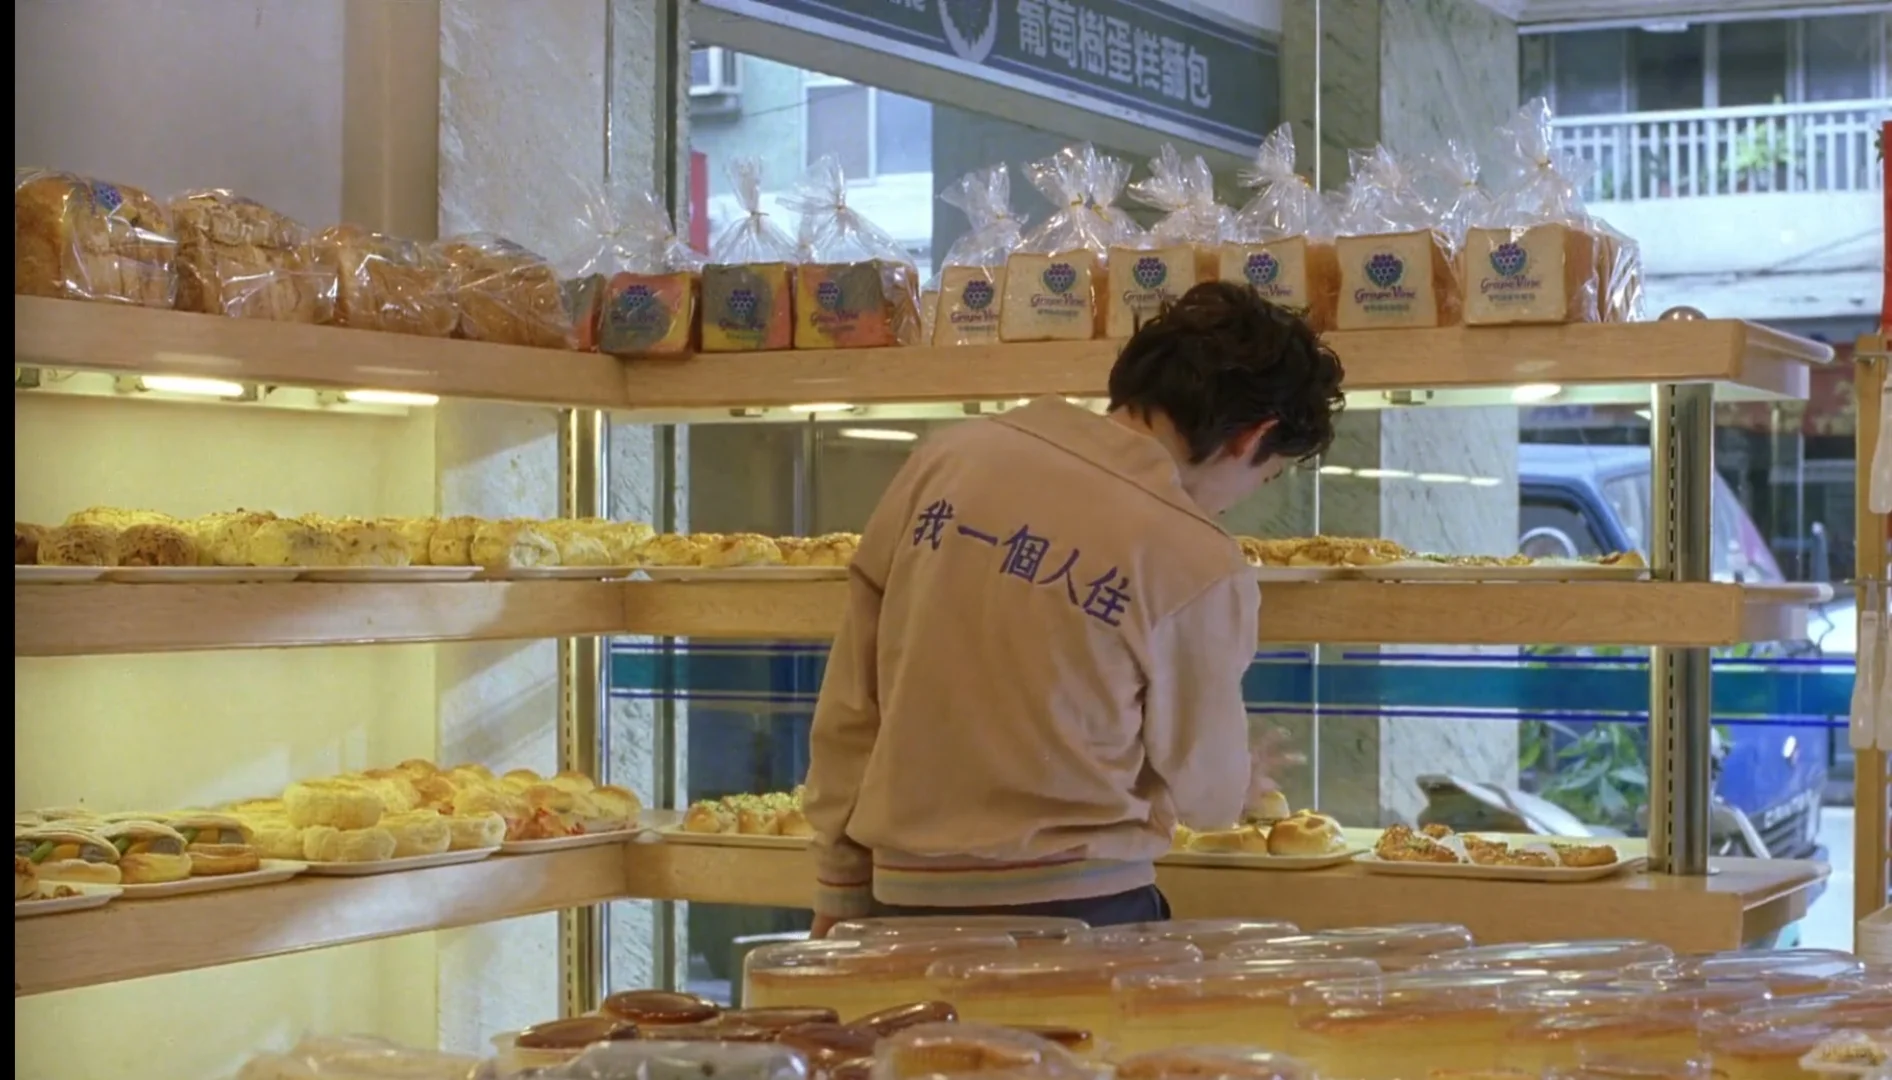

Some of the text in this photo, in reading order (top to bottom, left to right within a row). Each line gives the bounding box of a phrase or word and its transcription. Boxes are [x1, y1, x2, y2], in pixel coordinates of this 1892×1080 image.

[913, 498, 1131, 627] 我一個人住
